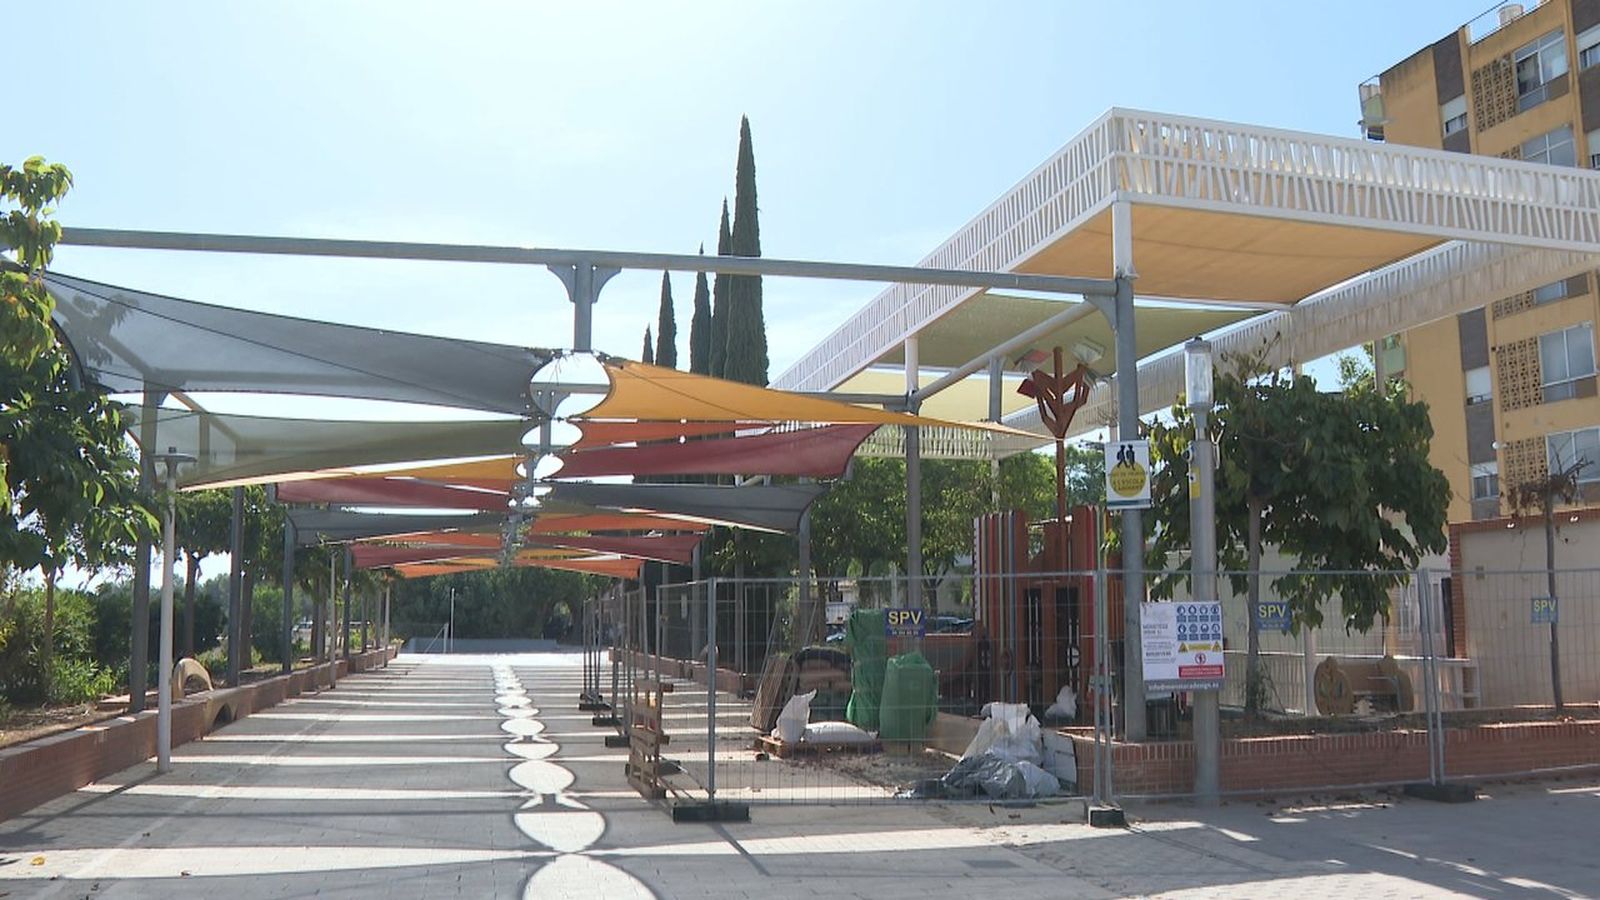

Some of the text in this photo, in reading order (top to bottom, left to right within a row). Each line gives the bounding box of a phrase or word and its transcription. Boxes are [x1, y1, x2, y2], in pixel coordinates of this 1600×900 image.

[1258, 604, 1286, 618] SPV
[1534, 599, 1557, 612] SPV
[888, 610, 922, 625] SPV
